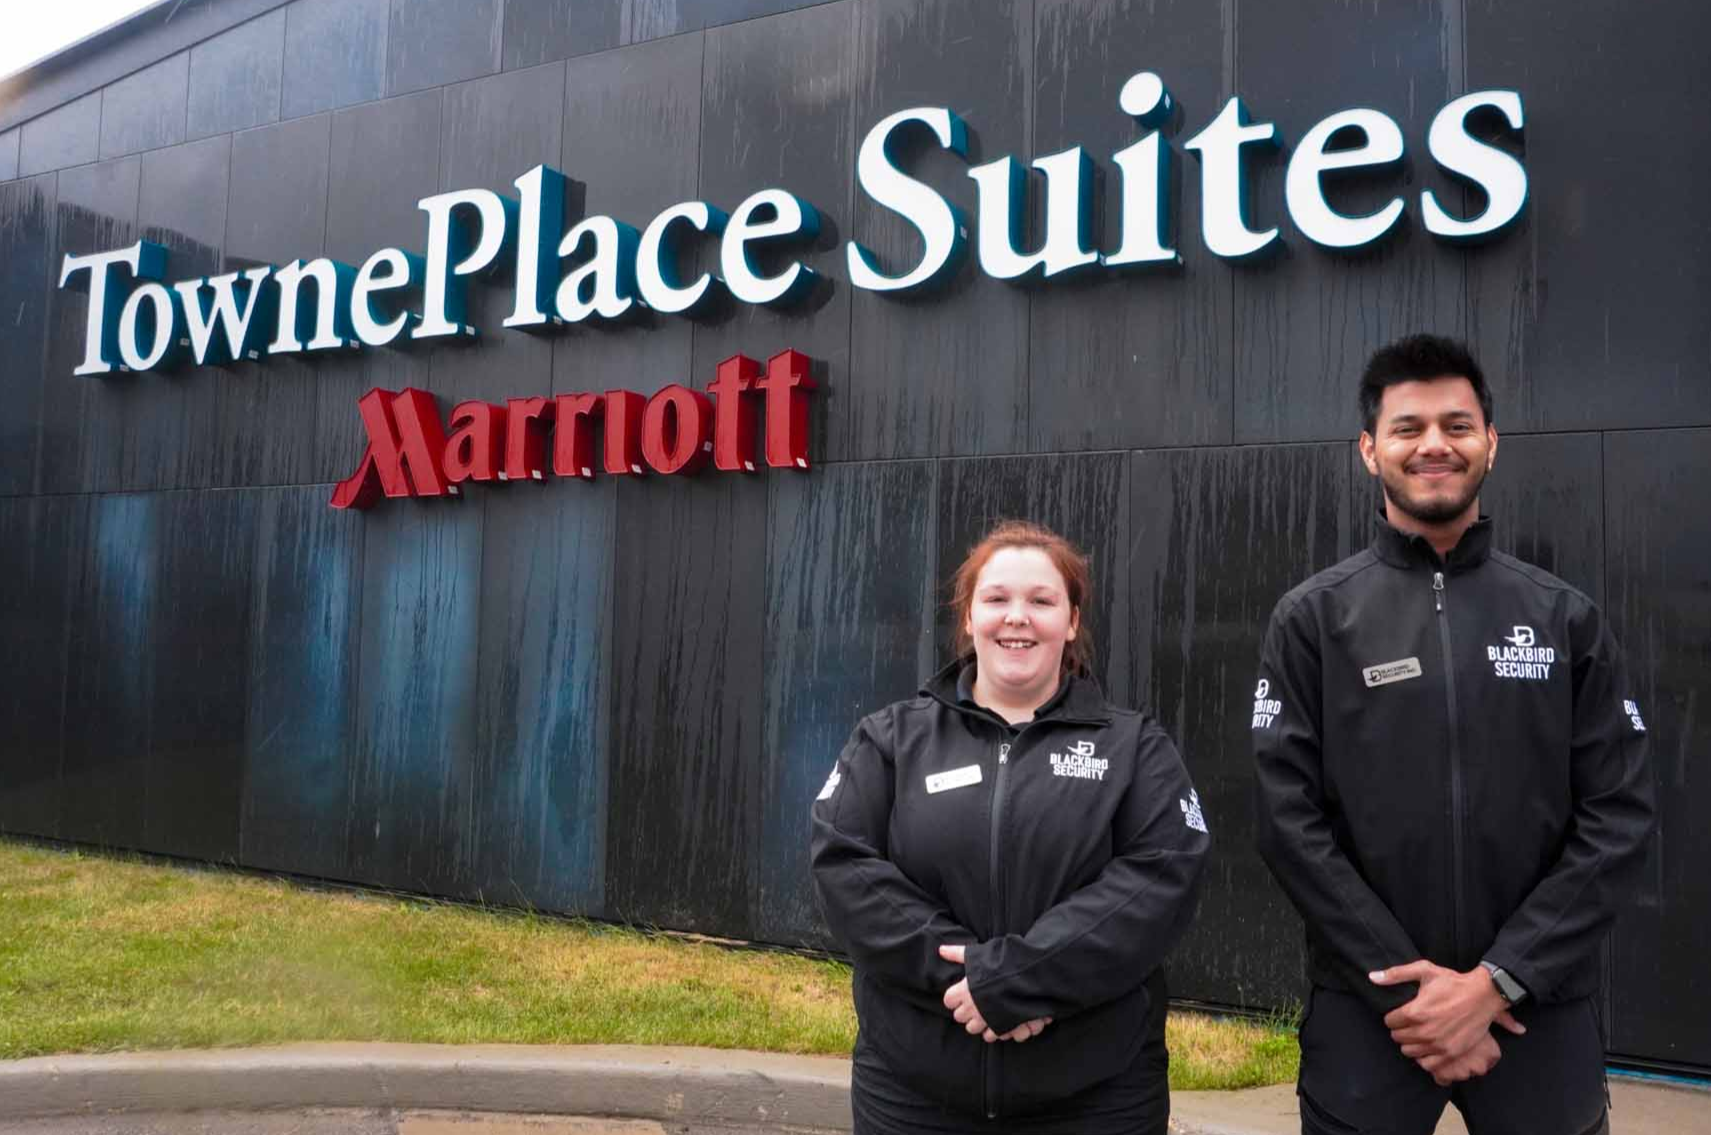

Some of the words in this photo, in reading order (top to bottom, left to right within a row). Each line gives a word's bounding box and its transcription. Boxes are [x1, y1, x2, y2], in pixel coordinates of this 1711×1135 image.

[58, 164, 808, 377] TownePlace
[846, 71, 1529, 291] Suites
[330, 348, 818, 510] Marriott
[1487, 646, 1554, 663] BLACKBIRD
[1494, 661, 1550, 680] SECURITY
[1050, 753, 1108, 770] BLACKBIRD
[1053, 764, 1104, 781] SECURITY
